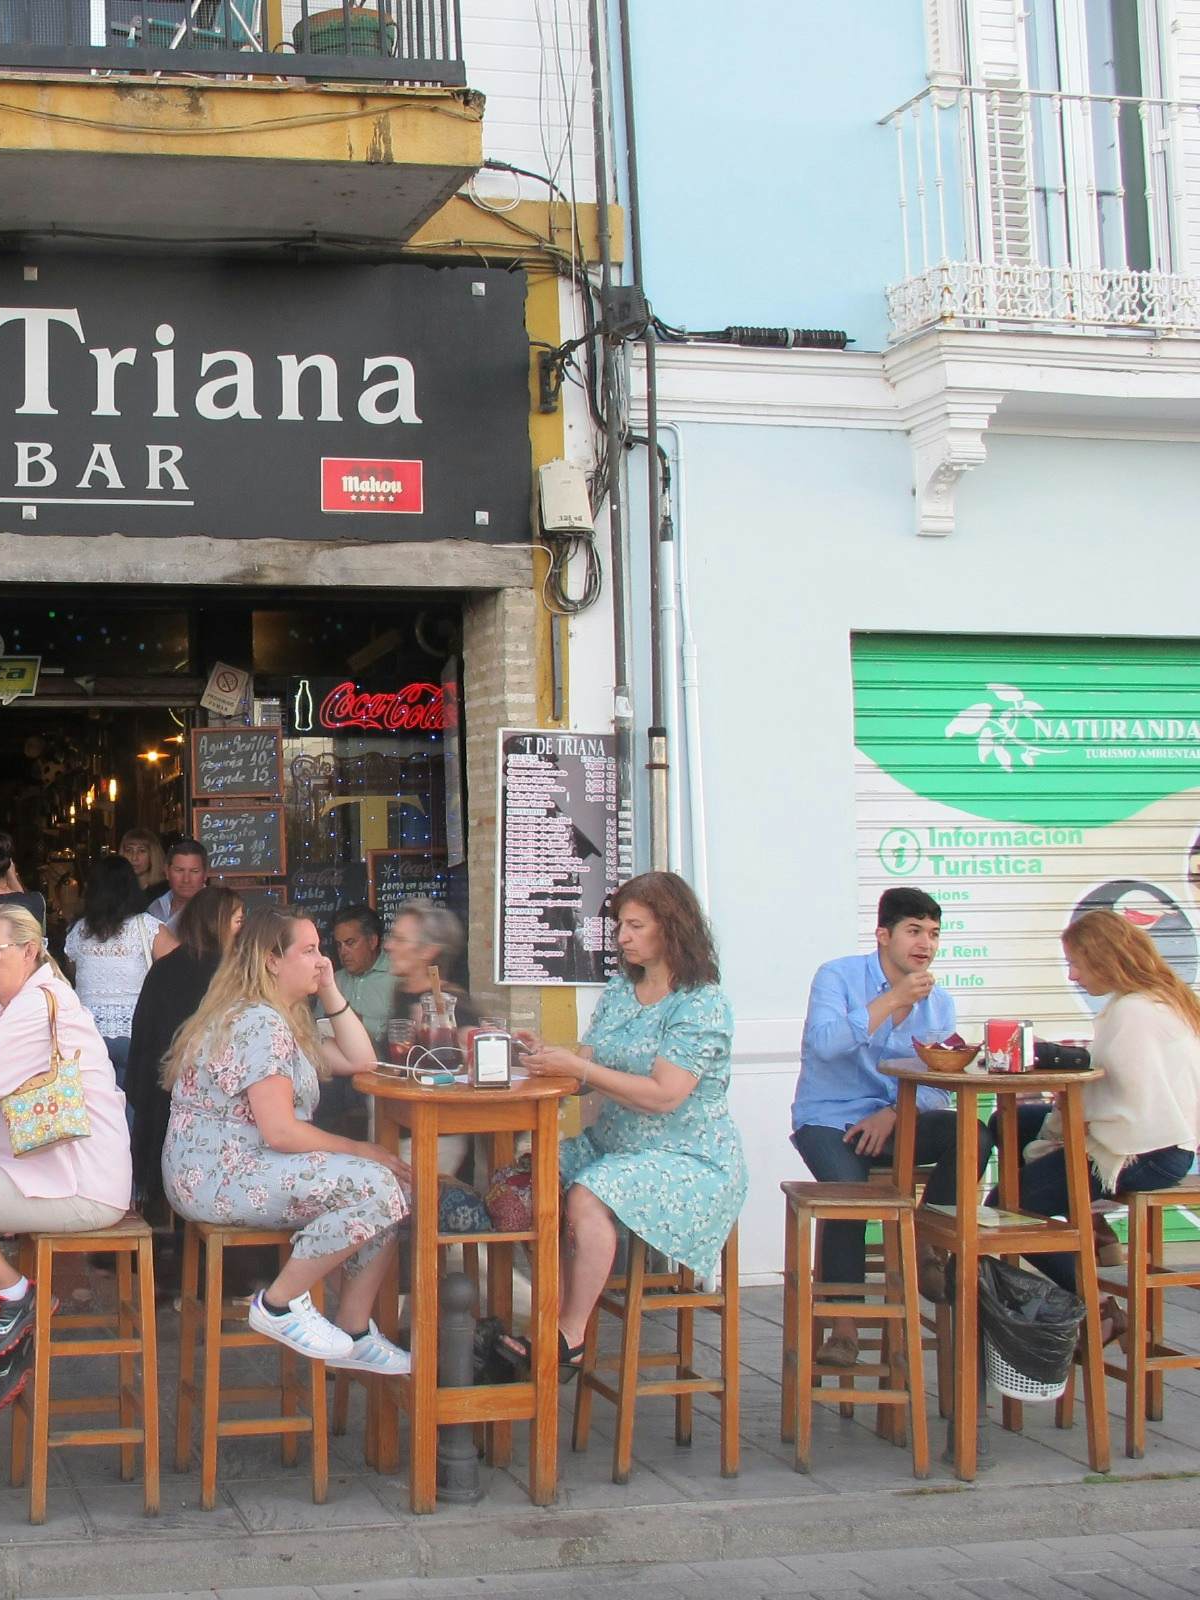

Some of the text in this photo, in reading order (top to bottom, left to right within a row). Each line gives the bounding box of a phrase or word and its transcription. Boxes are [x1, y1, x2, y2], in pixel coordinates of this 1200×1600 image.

[13, 441, 190, 490] BAR
[341, 475, 403, 493] Mahou
[319, 681, 458, 731] Coca-Cola
[1033, 718, 1200, 741] NATURANDA
[524, 737, 605, 756] T DE TRIANA
[1086, 748, 1137, 759] TURISMO
[952, 945, 989, 958] Rent
[955, 973, 985, 987] Info
